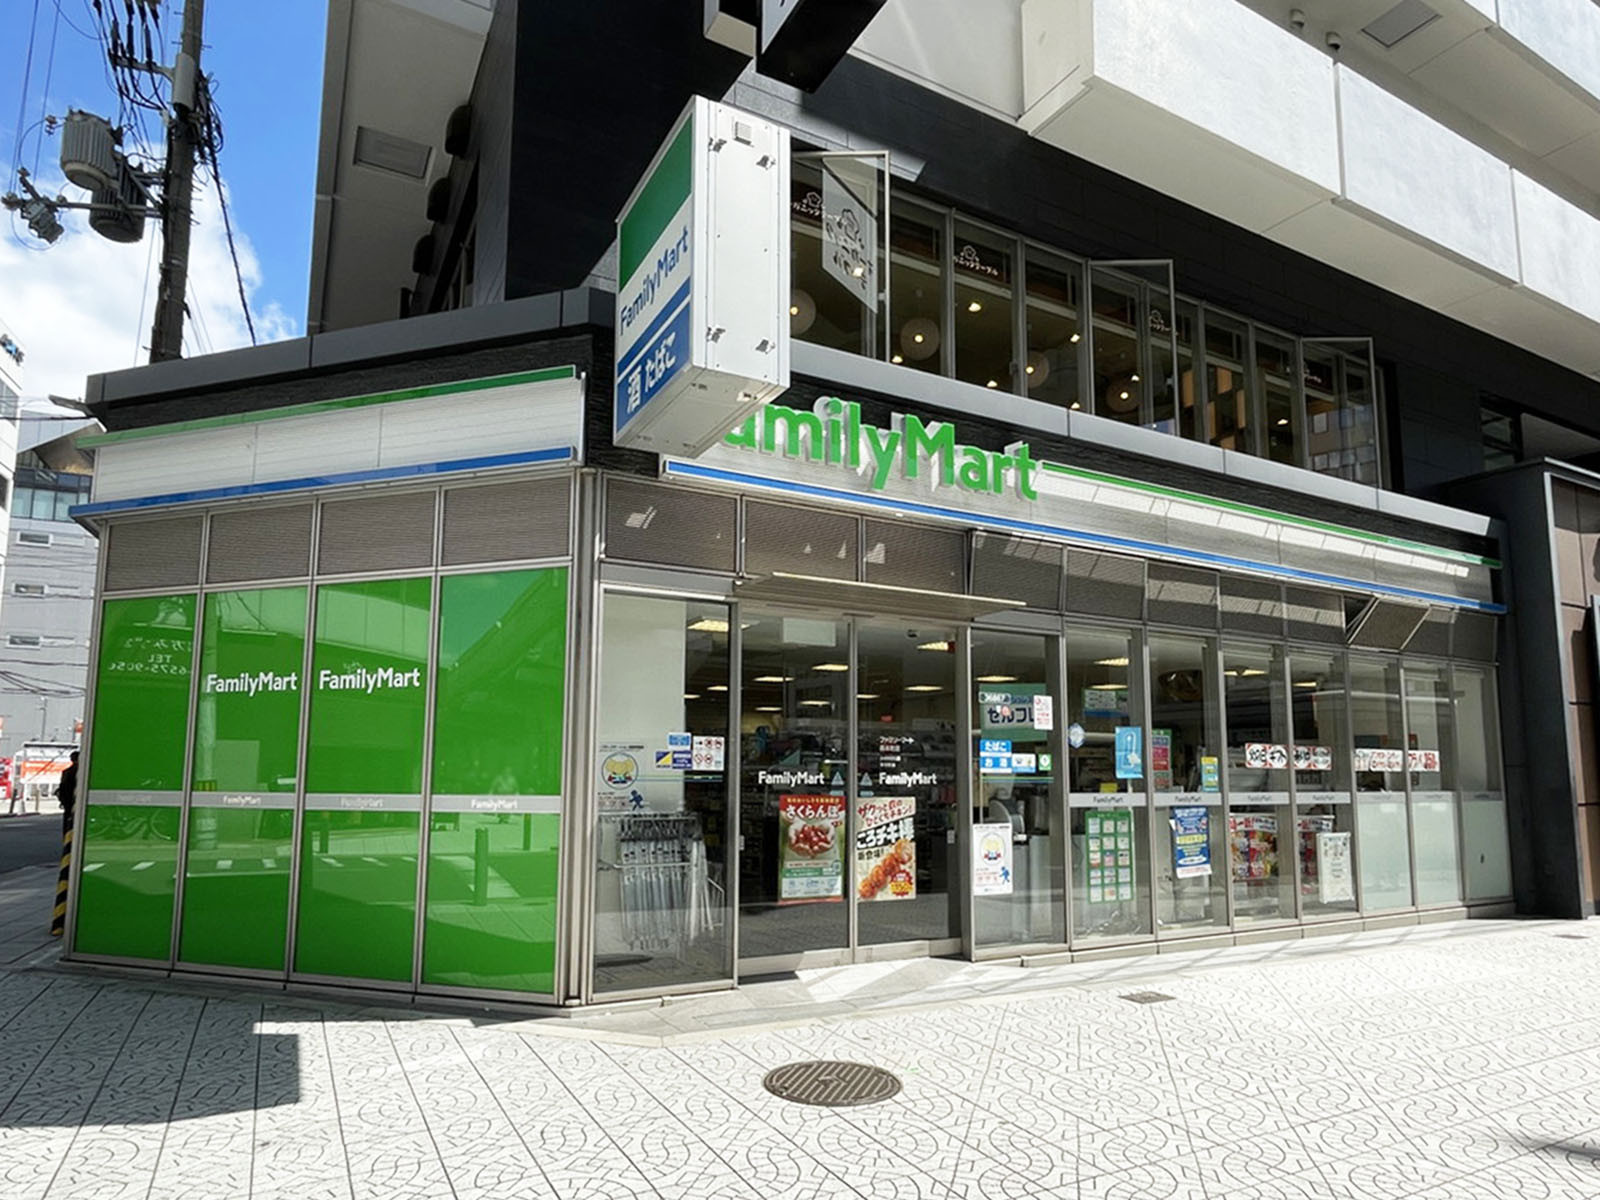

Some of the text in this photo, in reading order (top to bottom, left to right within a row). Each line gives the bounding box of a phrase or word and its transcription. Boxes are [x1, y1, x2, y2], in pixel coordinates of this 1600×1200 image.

[620, 226, 689, 336] FamilyMart
[627, 331, 676, 413] 酒 たばこ
[724, 398, 1038, 501] amilyMart
[206, 671, 298, 697] FamilyMart
[319, 667, 421, 694] FamilyMart
[758, 771, 825, 787] FamilyMart
[879, 772, 938, 787] FamilyMart
[471, 799, 518, 810] FamilyMart
[786, 804, 842, 819] さくらんぼ
